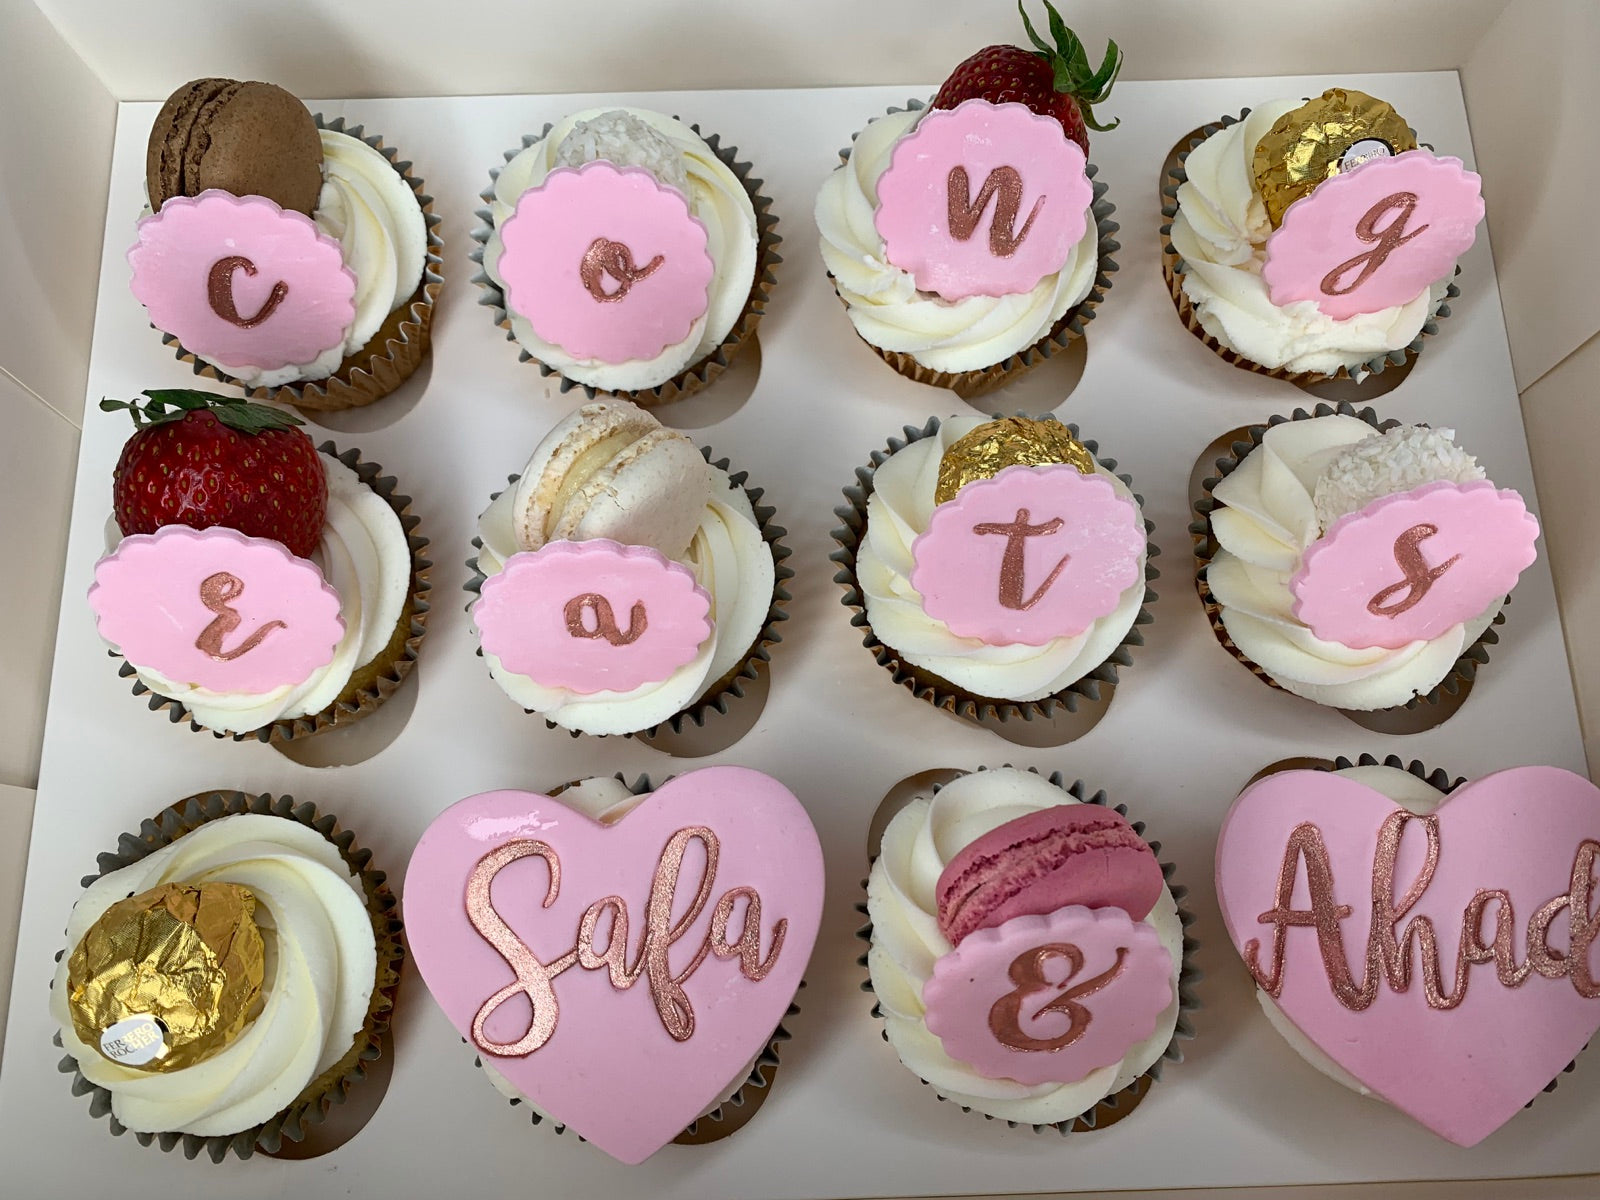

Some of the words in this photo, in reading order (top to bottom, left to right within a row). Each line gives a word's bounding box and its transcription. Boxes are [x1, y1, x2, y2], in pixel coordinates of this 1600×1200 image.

[947, 164, 1047, 260] n
[1320, 191, 1430, 297] g
[563, 593, 650, 647] a
[464, 825, 789, 1060] Safa
[987, 941, 1130, 1054] &
